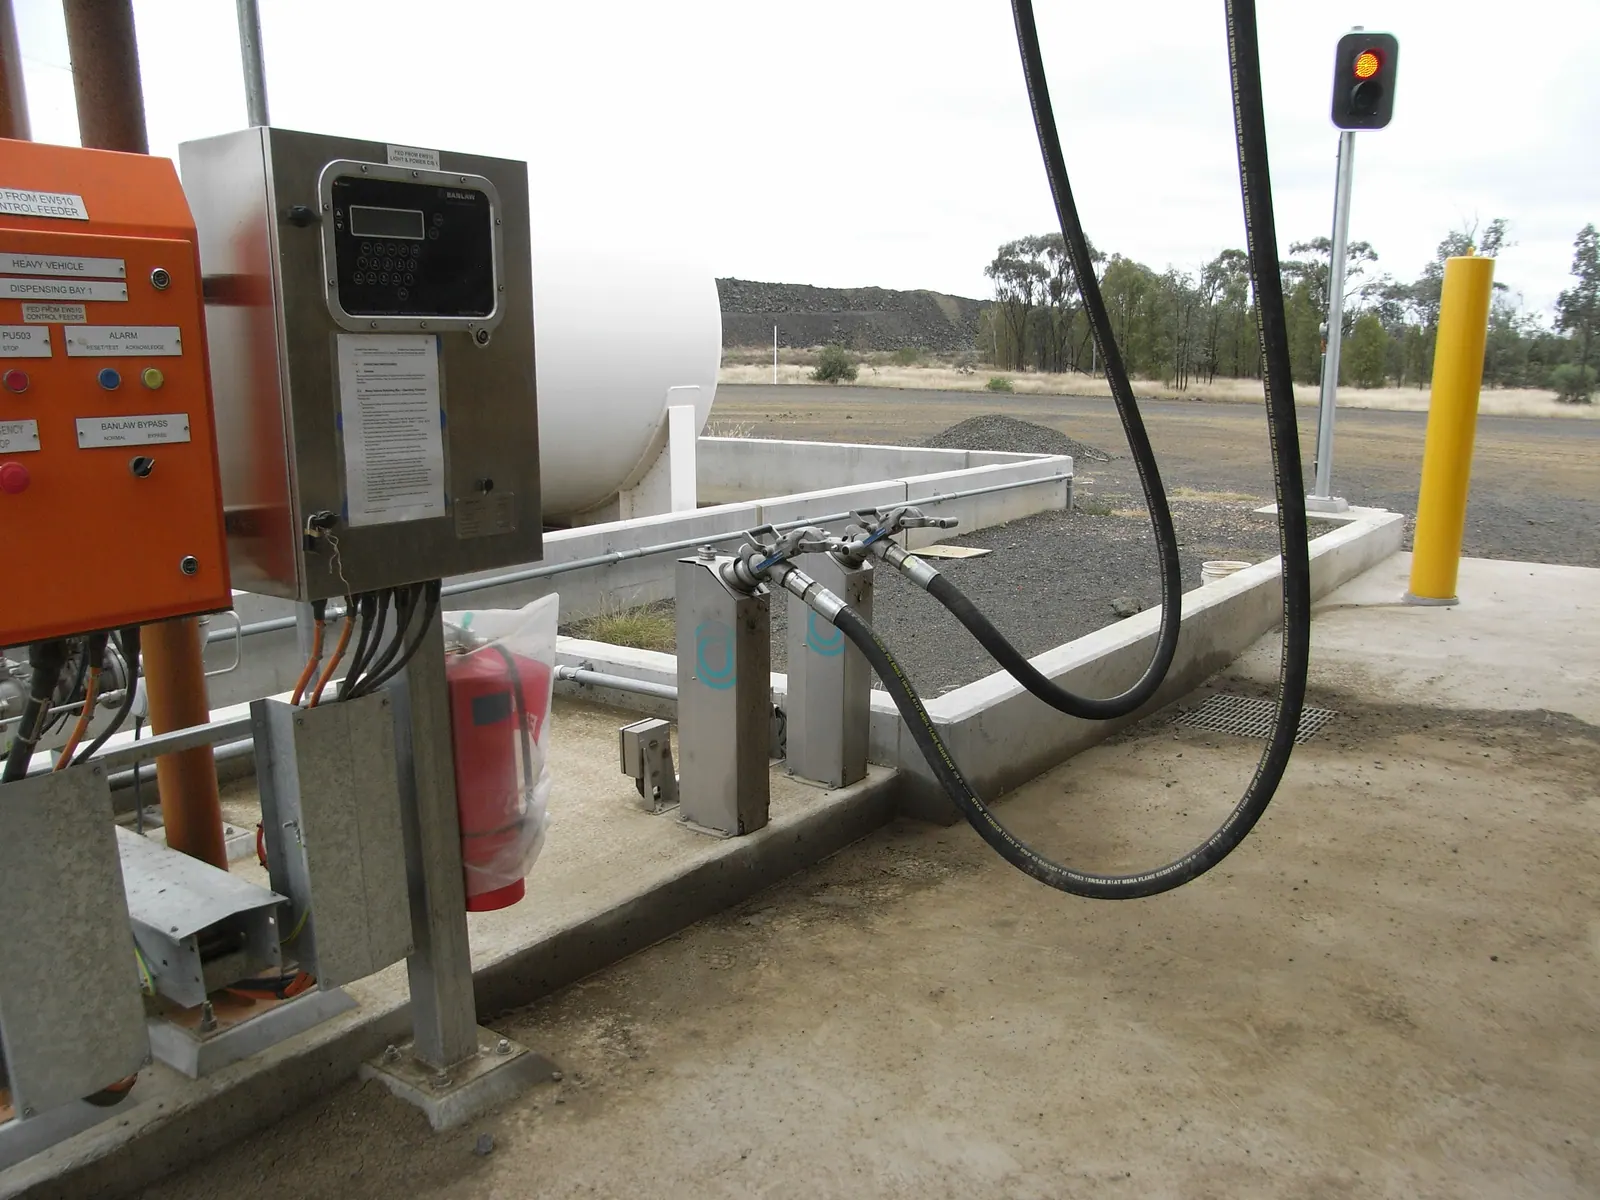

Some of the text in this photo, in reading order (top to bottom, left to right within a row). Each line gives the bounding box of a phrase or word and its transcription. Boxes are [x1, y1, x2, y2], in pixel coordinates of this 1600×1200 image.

[6, 192, 38, 202] FROM
[39, 194, 74, 206] EW510
[446, 192, 476, 200] BANLAW
[38, 206, 80, 216] FEEDER
[12, 260, 84, 270] HEAVY VEHICLE
[10, 284, 68, 294] DISPENSING
[69, 286, 86, 294] BAY
[2, 332, 31, 340] PU503
[109, 332, 138, 340] ALARM
[101, 420, 168, 430] BANLAW BYPASS
[935, 742, 955, 771] RESISTANT
[1138, 873, 1156, 882] FLAME
[1154, 861, 1184, 877] RESISTANT
